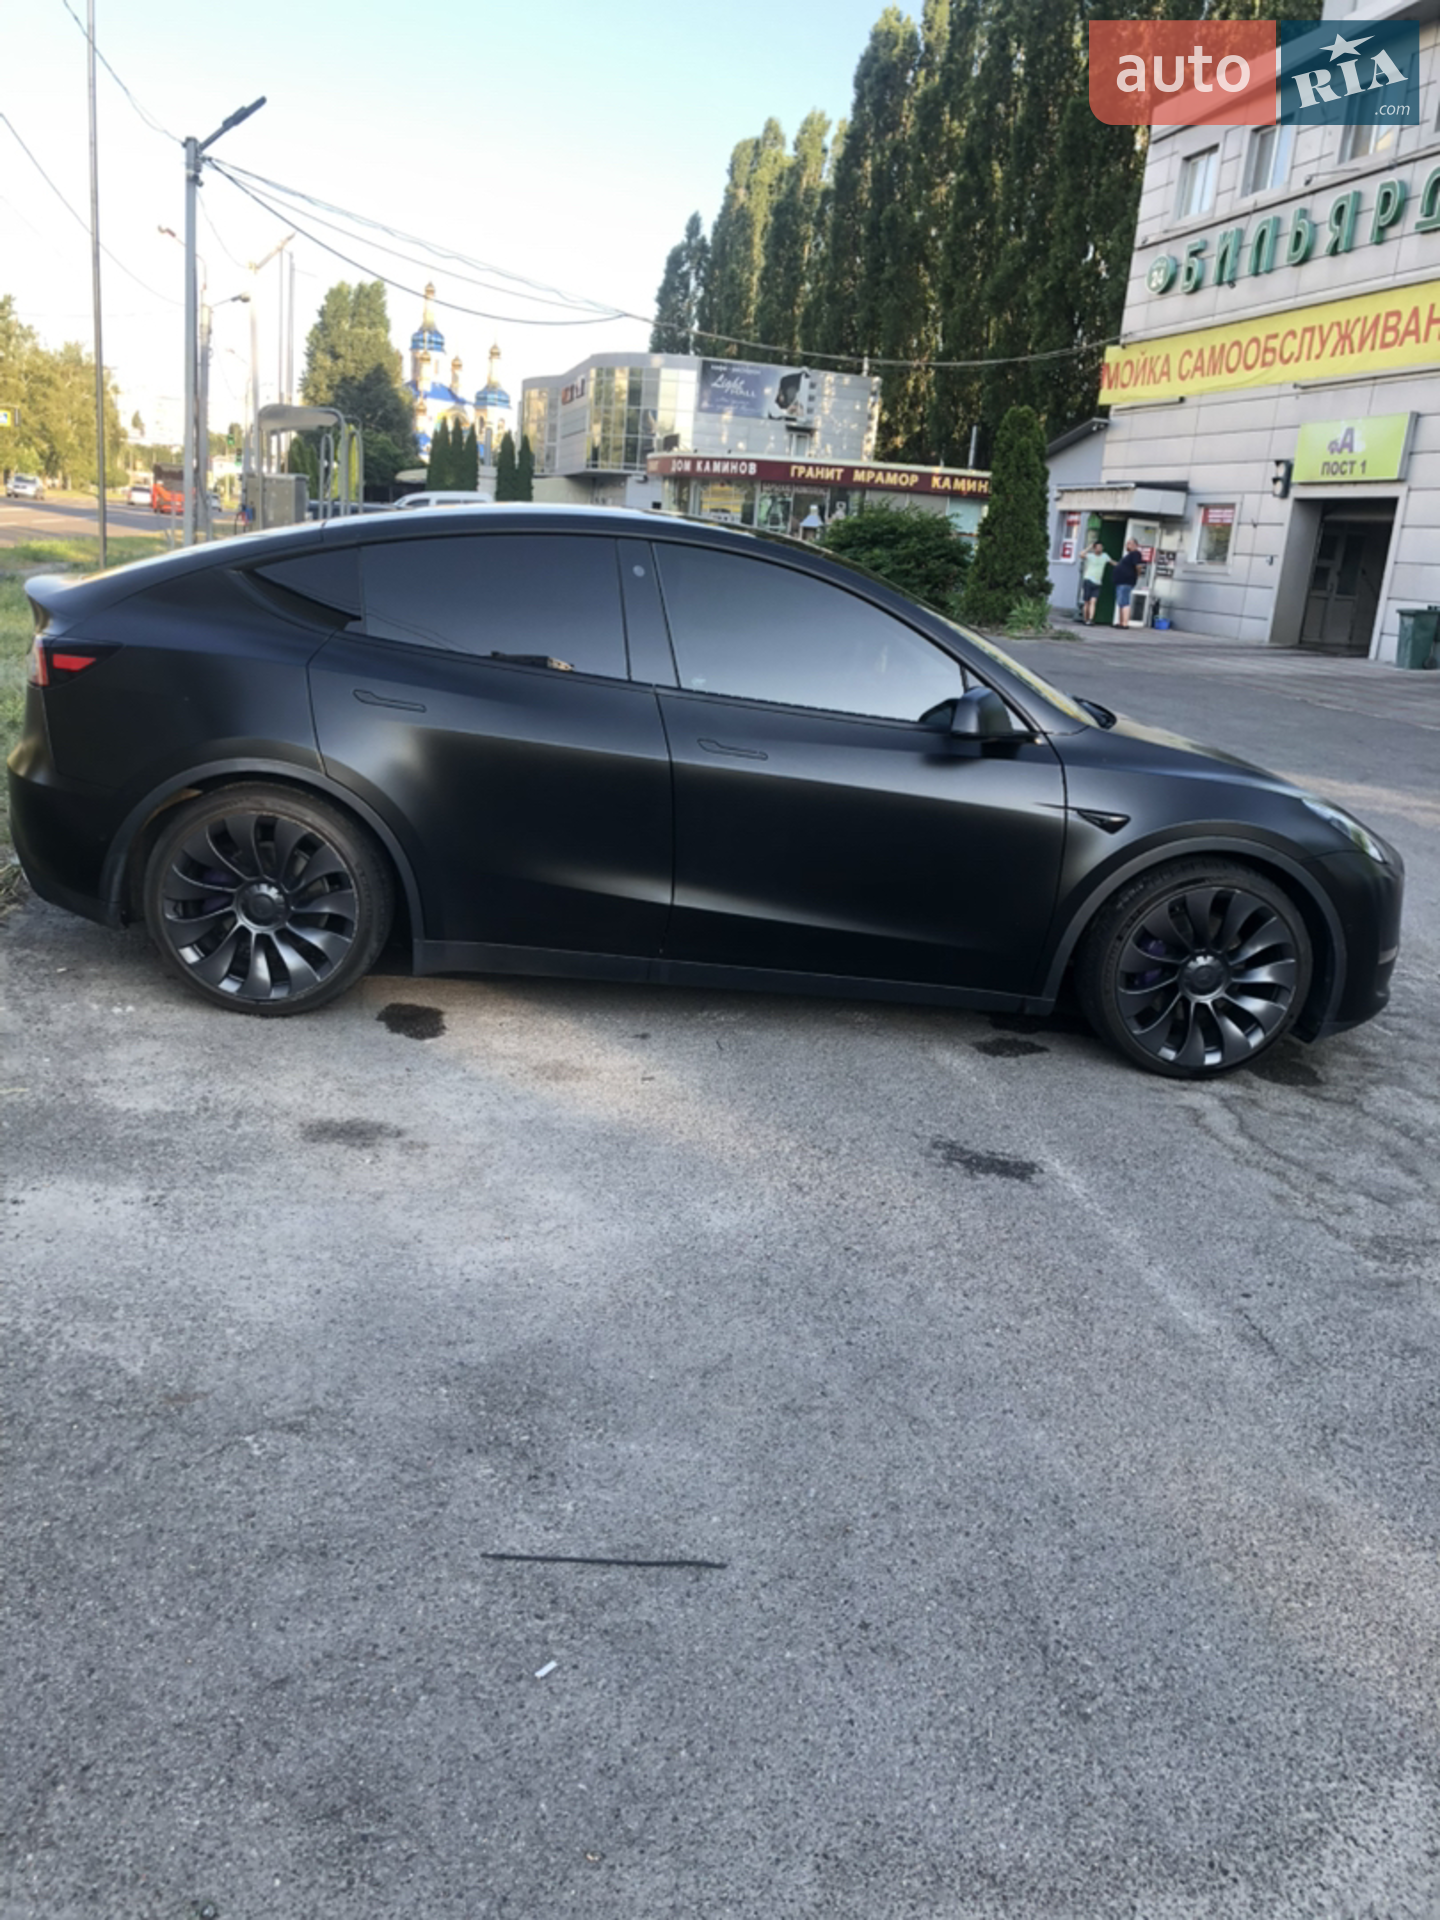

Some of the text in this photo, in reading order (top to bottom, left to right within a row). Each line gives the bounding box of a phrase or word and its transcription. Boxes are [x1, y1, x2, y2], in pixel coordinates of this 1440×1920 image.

[1099, 351, 1172, 391] МОЙКА
[670, 459, 692, 473] ДОМ
[696, 460, 758, 476] КАМИНОВ
[790, 464, 845, 482] ГРАНИТ
[853, 468, 919, 487] МРАМОР
[1320, 459, 1368, 477] ПОСТ 1
